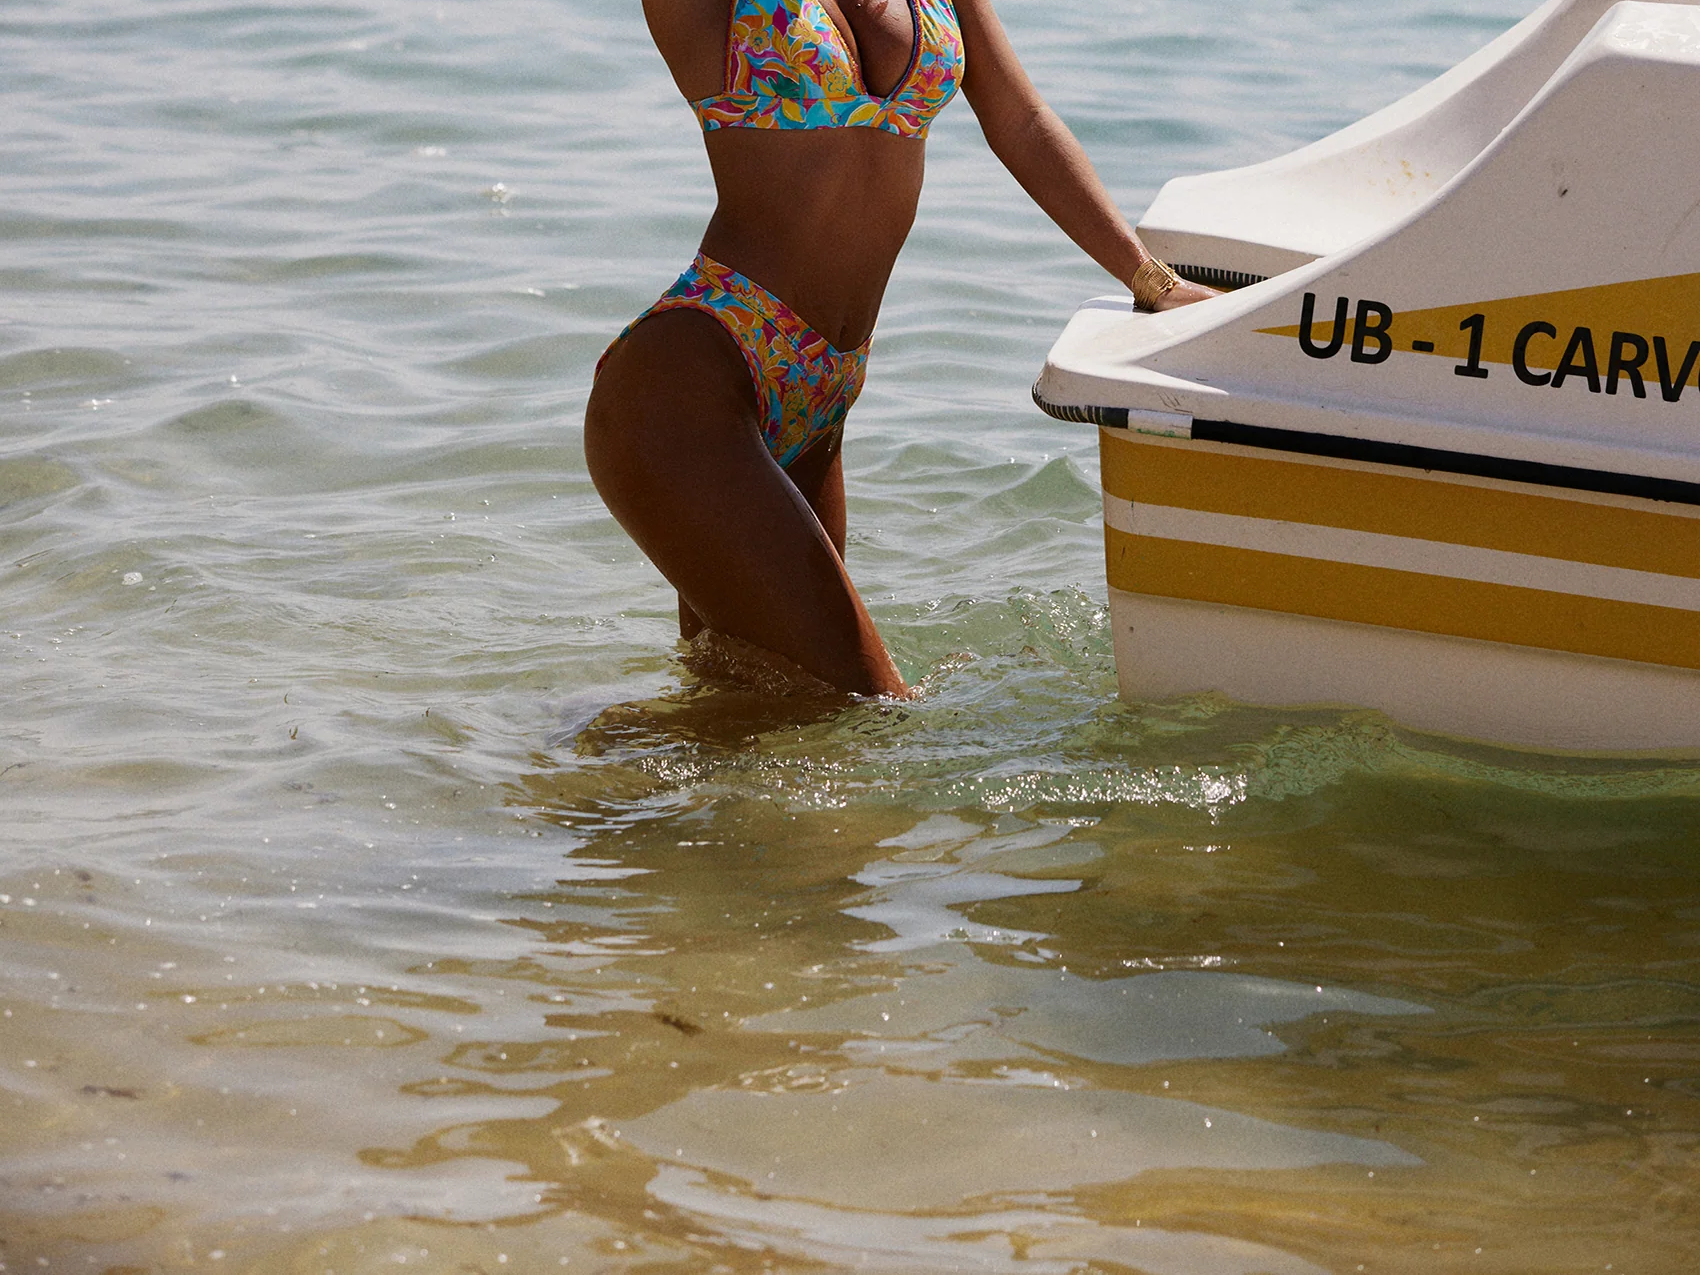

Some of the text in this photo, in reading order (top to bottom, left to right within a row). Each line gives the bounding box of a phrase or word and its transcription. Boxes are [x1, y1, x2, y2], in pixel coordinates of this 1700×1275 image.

[1298, 292, 1700, 403] UB - 1 CARV
